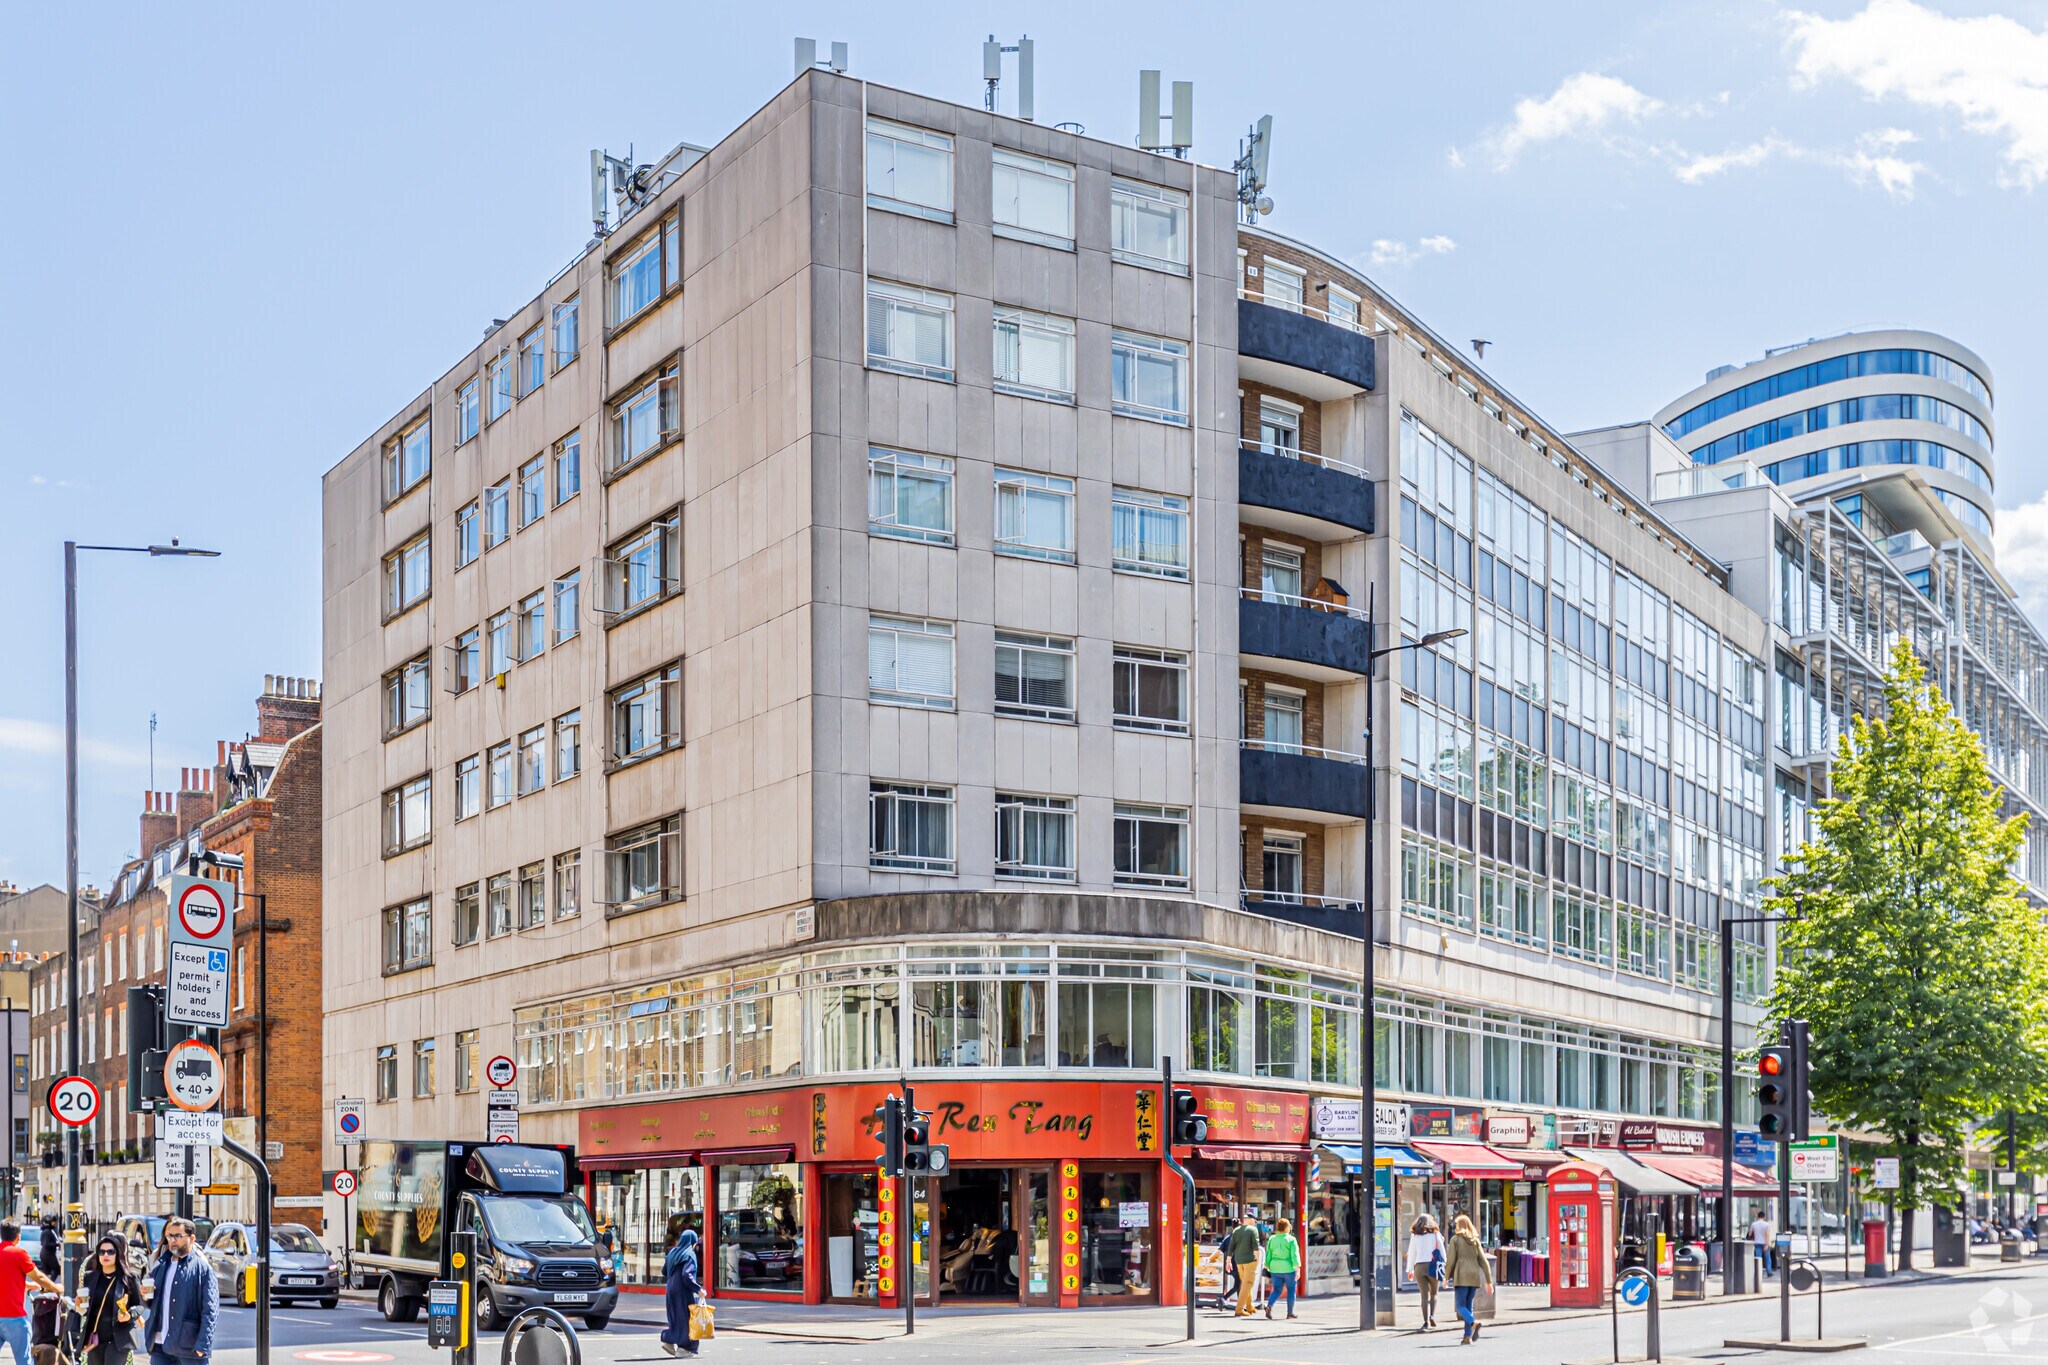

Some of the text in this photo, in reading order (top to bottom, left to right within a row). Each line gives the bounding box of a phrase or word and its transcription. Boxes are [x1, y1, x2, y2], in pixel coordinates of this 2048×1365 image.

[174, 951, 206, 964] Except
[179, 971, 210, 982] permit
[177, 982, 211, 994] holders
[215, 980, 221, 990] F
[190, 997, 207, 1006] and
[174, 1005, 221, 1019] for access
[188, 1084, 202, 1095] 40
[59, 1091, 93, 1111] 20
[168, 1116, 220, 1128] Except for
[937, 1100, 1093, 1140] Ren Tang
[1136, 1093, 1152, 1151] 華仁堂
[1376, 1108, 1398, 1126] SALON
[177, 1130, 211, 1139] access
[1490, 1126, 1526, 1136] Graphite
[1624, 1125, 1654, 1135] Al Balad
[336, 1178, 353, 1189] 20
[374, 1190, 424, 1204] COUNTY SUPPLIES
[914, 1190, 926, 1199] 64
[432, 1304, 456, 1315] WAIT
